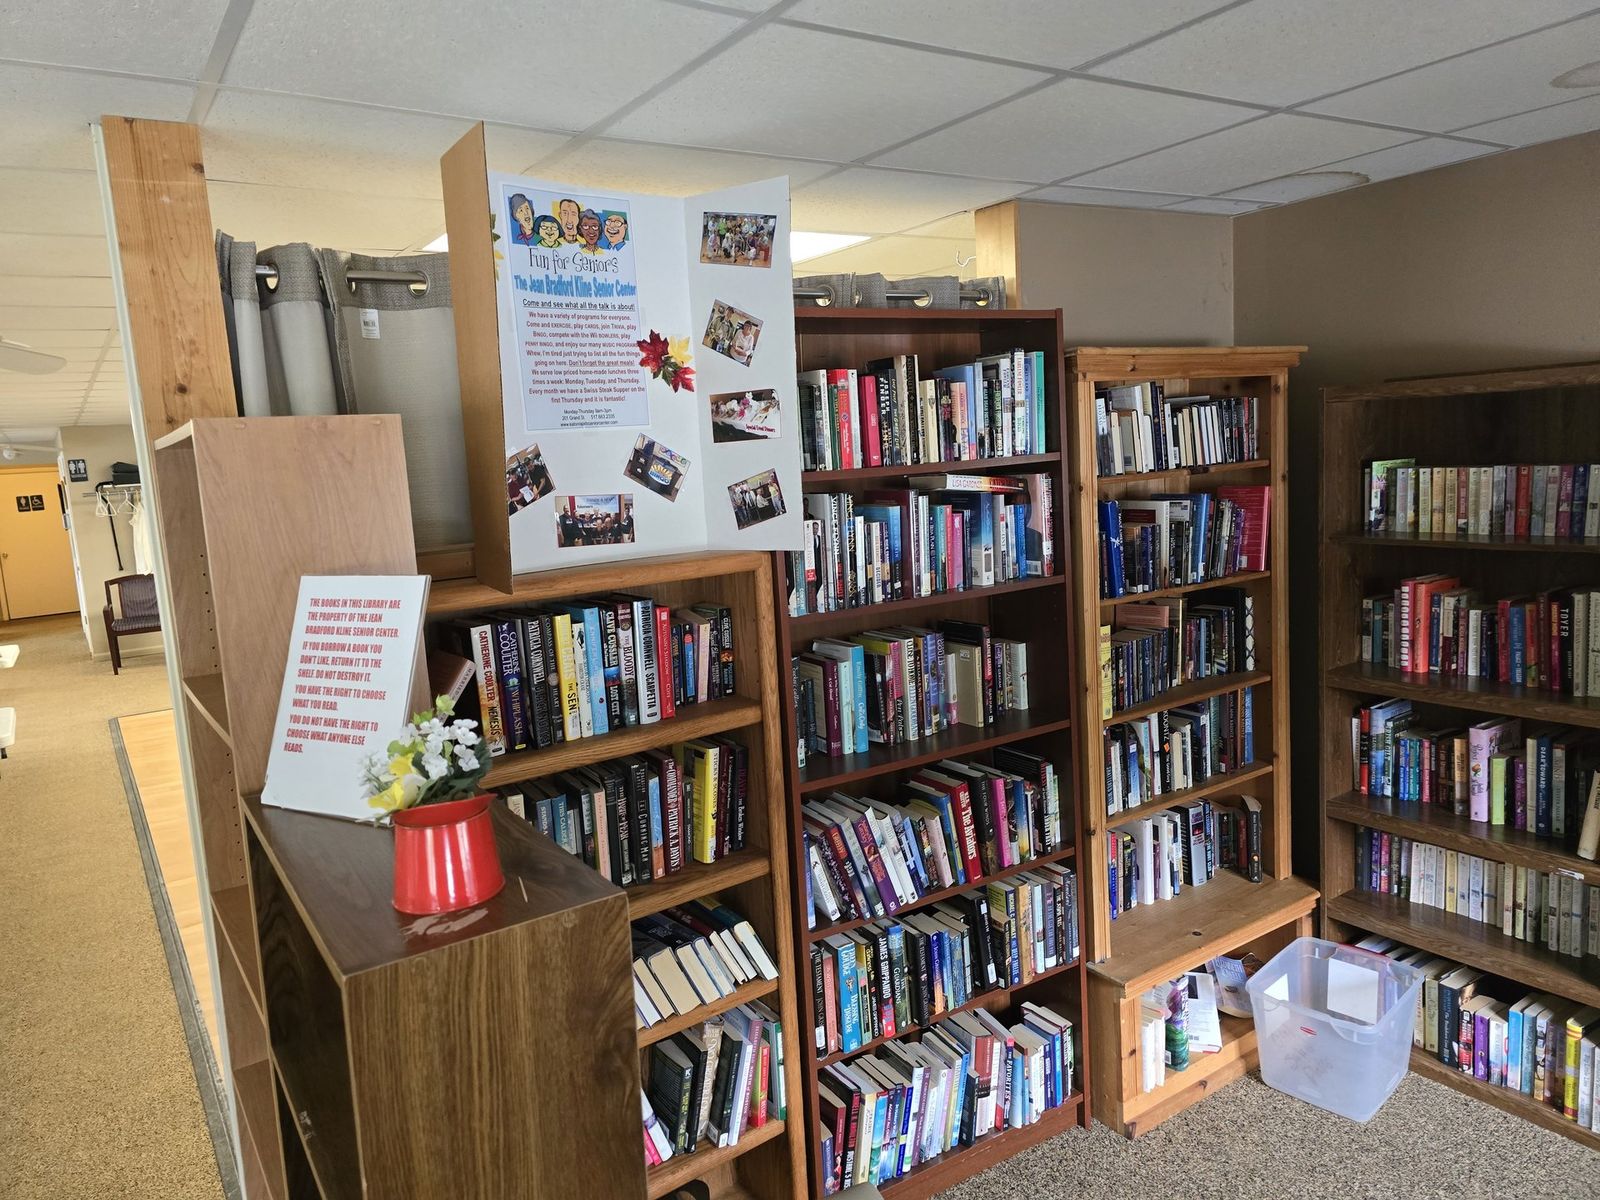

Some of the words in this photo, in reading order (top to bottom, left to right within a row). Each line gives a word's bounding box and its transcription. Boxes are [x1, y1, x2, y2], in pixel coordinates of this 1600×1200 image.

[529, 247, 549, 270] Fun
[552, 250, 569, 274] for
[573, 252, 618, 273] Seniors
[514, 275, 527, 291] The
[529, 275, 545, 292] Jean
[546, 275, 574, 297] Bradford
[575, 276, 592, 298] Kline
[593, 278, 614, 297] Senior
[615, 281, 636, 296] Center
[650, 472, 670, 484] BINGO
[952, 479, 964, 489] LISA
[310, 598, 320, 607] THE
[321, 599, 340, 608] BOOKS
[341, 599, 348, 608] IN
[349, 600, 362, 608] THIS
[363, 600, 388, 608] LIBRARY
[389, 600, 400, 609] ARE
[308, 612, 318, 620] THE
[319, 612, 347, 622] PROPERTY
[348, 613, 356, 622] OF
[357, 613, 367, 622] THE
[368, 614, 382, 622] JEAN
[605, 612, 616, 633] CLIVE
[641, 606, 652, 635] PATRICIA
[1559, 608, 1569, 637] TOYER
[305, 626, 334, 635] BRADFORD
[336, 627, 352, 636] KLINE
[353, 627, 374, 637] SENIOR
[527, 620, 542, 648] PATRICIA
[545, 617, 554, 647] COMPASS
[302, 641, 308, 650] IF
[309, 642, 319, 650] YOU
[320, 642, 346, 652] BORROW
[347, 644, 351, 652] A
[352, 644, 368, 653] BOOK
[370, 644, 382, 654] YOU
[478, 630, 492, 670] CATHERINE
[500, 632, 513, 676] COULTER
[509, 632, 520, 674] CATHERINE
[548, 648, 554, 658] OF
[607, 635, 618, 666] CUSSLER
[642, 636, 654, 671] CORNWELL
[300, 655, 316, 664] DON'T
[330, 657, 354, 667] RETURN
[354, 658, 360, 667] IT
[361, 659, 370, 667] TO
[370, 659, 382, 668] THE
[531, 650, 545, 684] CORNWELL
[624, 647, 634, 676] BLOODY
[316, 670, 324, 678] DO
[325, 670, 336, 679] NOT
[337, 671, 364, 681] DESTROY
[484, 671, 496, 702] COULTER
[293, 698, 310, 708] WHAT
[310, 700, 321, 709] YOU
[295, 684, 306, 694] YOU
[307, 686, 321, 695] HAVE
[322, 686, 333, 696] THE
[334, 687, 352, 698] RIGHT
[353, 689, 360, 698] TO
[362, 690, 386, 700] CHOOSE
[552, 688, 560, 708] HEART
[610, 686, 618, 700] LOST
[645, 673, 656, 709] SCARPETTA
[511, 689, 523, 734] WHIPLASH
[610, 701, 620, 715] CITY
[290, 714, 301, 724] YOU
[302, 716, 310, 725] DO
[311, 716, 322, 726] NOT
[323, 717, 338, 728] HAVE
[339, 719, 350, 729] THE
[351, 720, 370, 730] RIGHT
[370, 721, 378, 732] TO
[488, 706, 503, 736] NEMESIS
[1162, 710, 1170, 742] KOONTZ
[287, 728, 310, 739] CHOOSE
[311, 730, 328, 741] WHAT
[328, 732, 351, 743] ANYONE
[351, 735, 366, 745] ELSE
[638, 814, 648, 845] CUNNING
[668, 808, 679, 837] PATRICK
[962, 810, 972, 824] The
[641, 847, 649, 862] MAN
[964, 826, 978, 860] Aviators
[670, 847, 680, 866] DAVIS
[878, 937, 889, 960] JAMES
[815, 965, 823, 994] TESTAMENT
[881, 961, 891, 999] GRIPPANDO
[893, 968, 901, 1004] GUARDIANS
[920, 985, 928, 998] JOHN
[816, 998, 824, 1012] JOHN
[1004, 1060, 1013, 1100] FAVORITES
